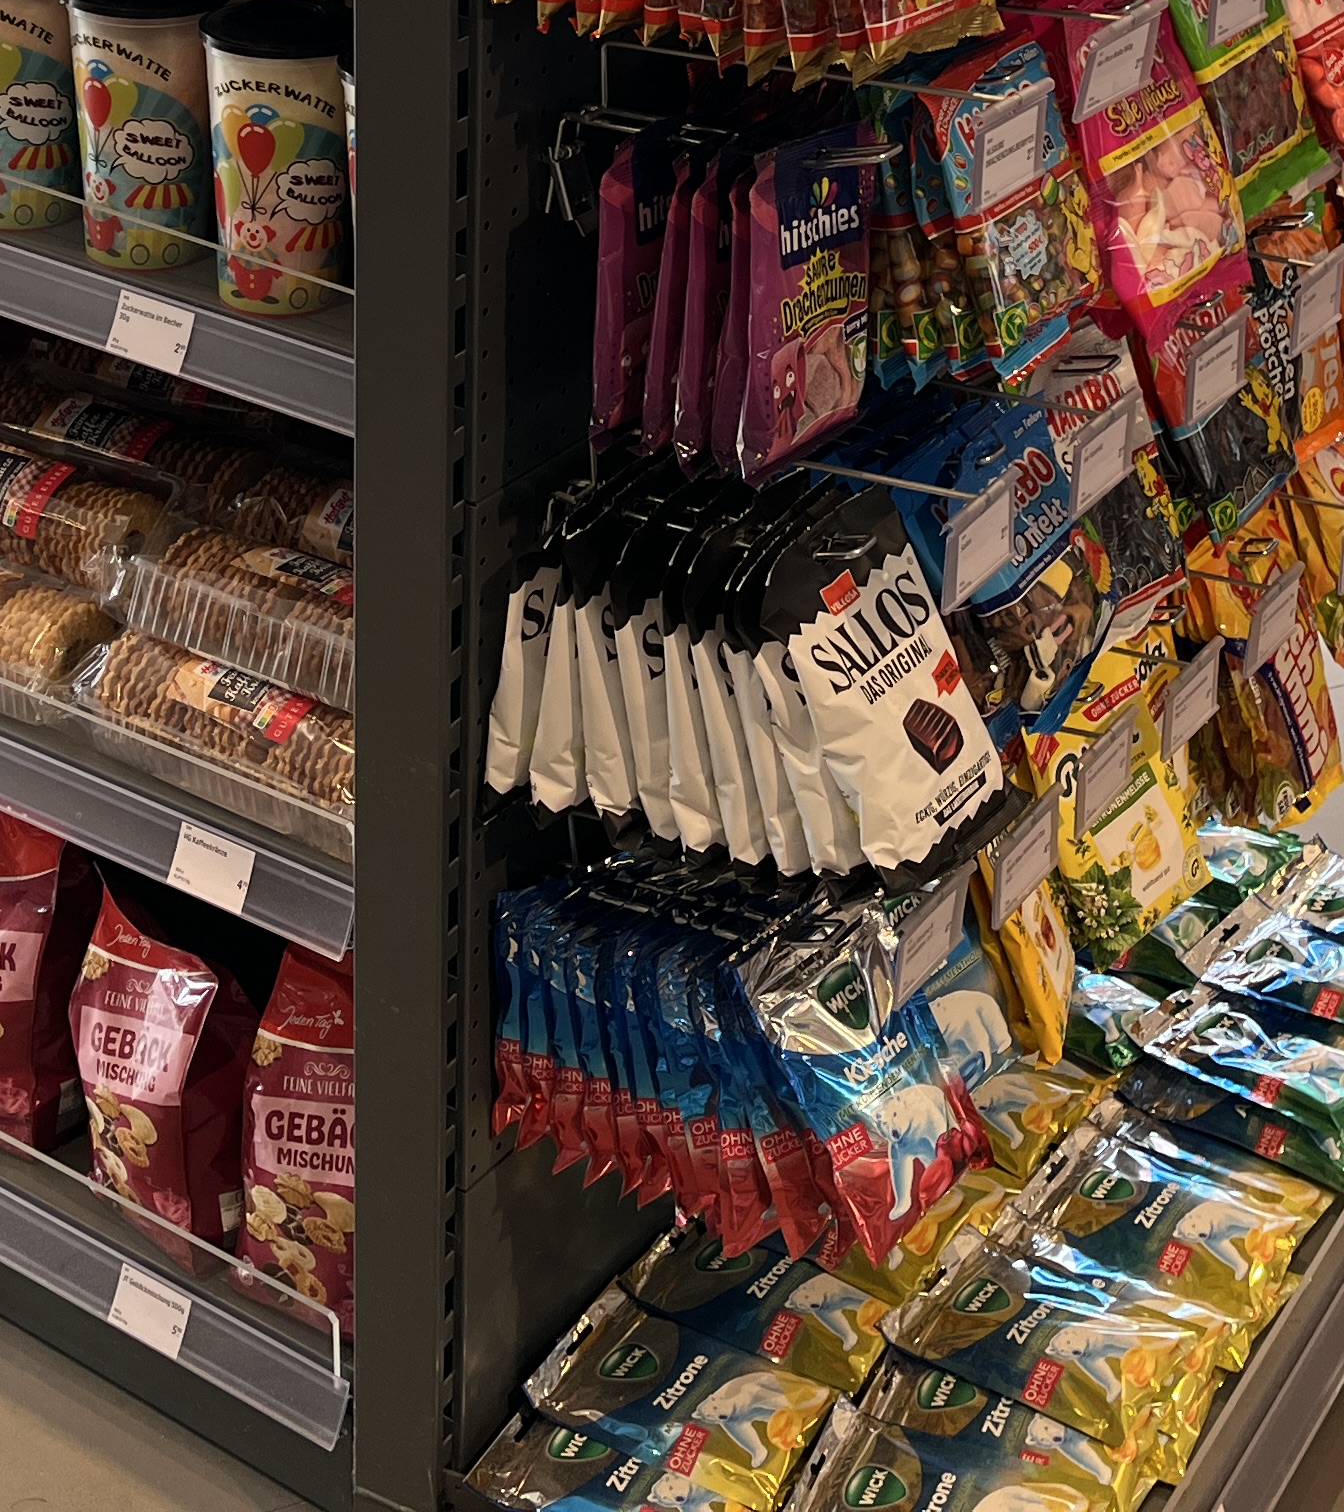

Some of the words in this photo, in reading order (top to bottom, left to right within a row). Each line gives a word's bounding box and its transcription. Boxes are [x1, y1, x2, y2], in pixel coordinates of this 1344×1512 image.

[6, 106, 68, 129] BALLOON
[8, 94, 63, 113] SWEET
[214, 78, 337, 119] ZUCKERWATTE
[122, 145, 188, 168] BALLOON
[124, 131, 183, 150] SWEET
[289, 173, 345, 189] SWEET
[779, 206, 861, 258] hitschies
[781, 274, 868, 334] Drachenzungen
[831, 589, 858, 613] VILLOSA
[810, 570, 930, 695] SALLOS
[860, 682, 885, 705] DAS
[883, 633, 933, 687] ORIGINAL
[825, 975, 866, 1016] WICK
[281, 1005, 316, 1031] Jeden
[282, 1074, 311, 1094] FEINE
[1092, 1170, 1119, 1203] WICK
[1134, 1180, 1182, 1232] Zitrone
[963, 1282, 998, 1313] WICK
[763, 1311, 789, 1352] OHNE
[774, 1316, 800, 1357] ZUCKER
[611, 1346, 646, 1378] WICK
[653, 1353, 708, 1411] Zitrone
[1025, 1359, 1052, 1402] OHNE
[1036, 1363, 1063, 1406] ZUCKER
[669, 1425, 697, 1470] OHNE
[680, 1430, 708, 1477] ZUCKER
[859, 1469, 888, 1505] WICK
